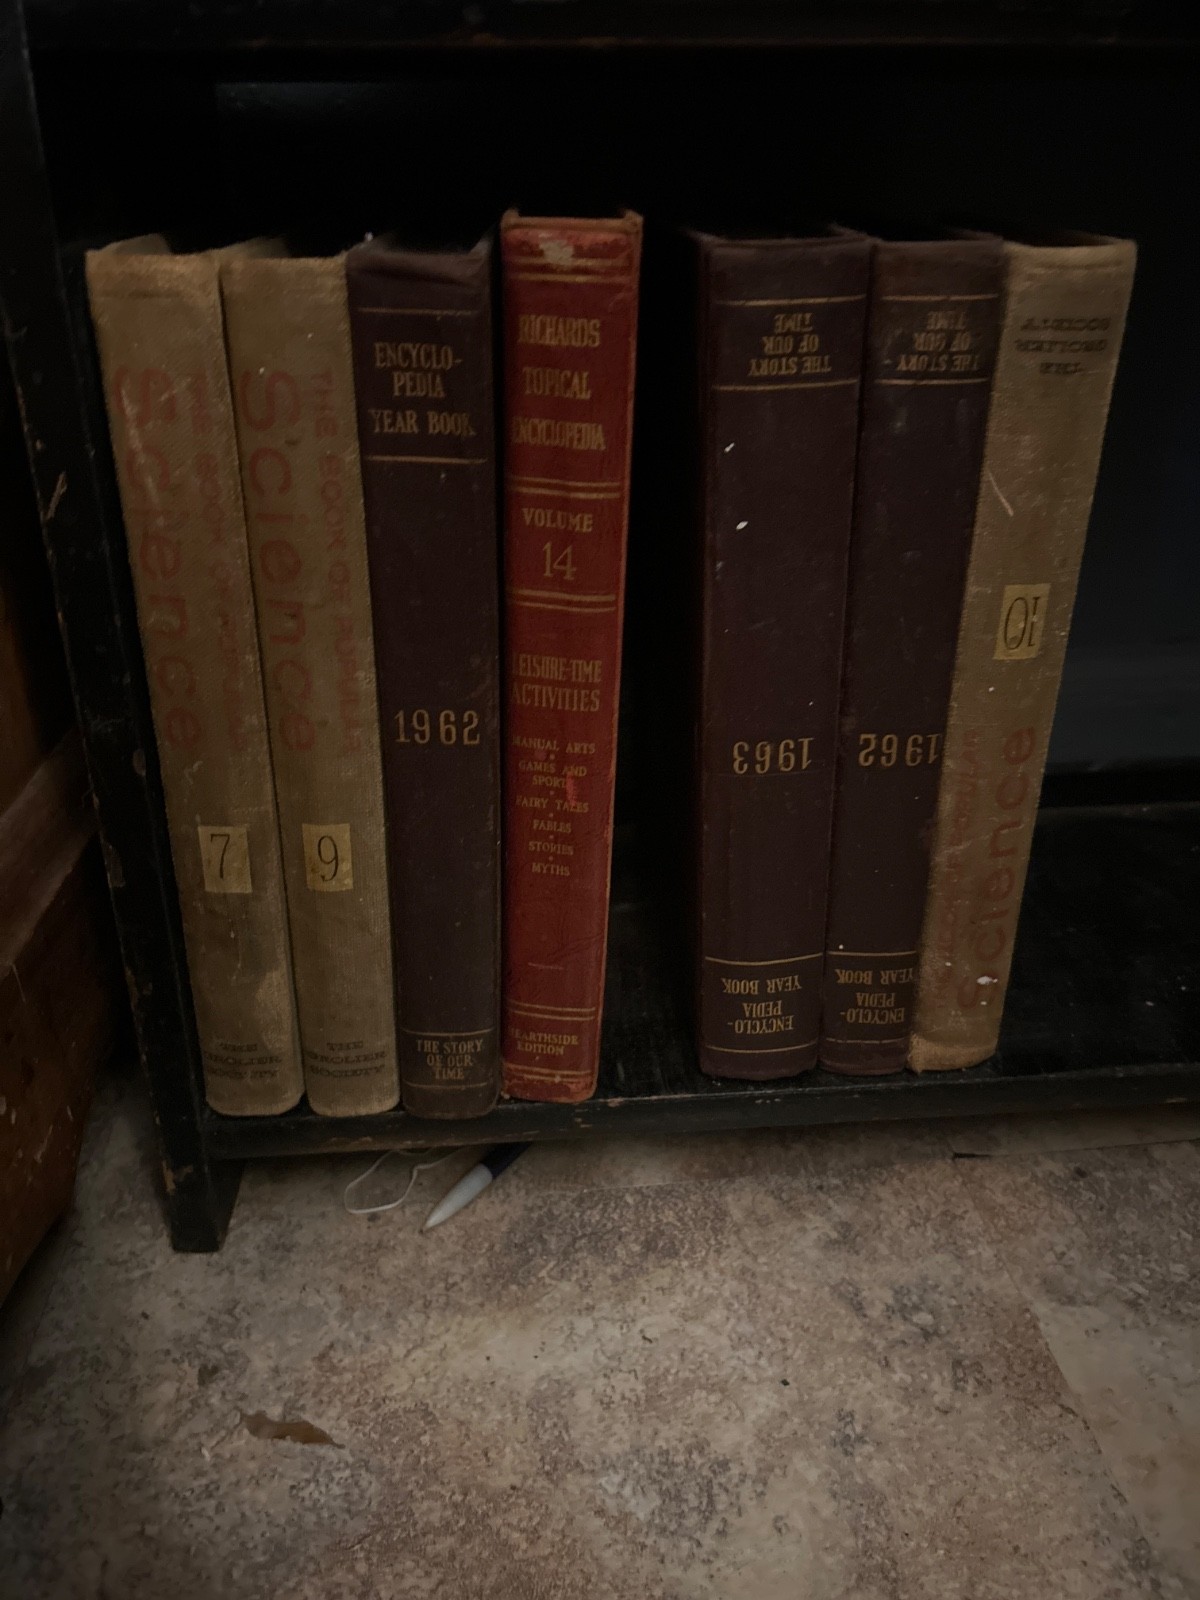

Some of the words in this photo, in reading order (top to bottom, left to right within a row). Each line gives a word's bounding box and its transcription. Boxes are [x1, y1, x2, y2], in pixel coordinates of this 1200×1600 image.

[517, 314, 600, 347] RICHARDS
[773, 312, 814, 334] TIME
[761, 335, 794, 355] OUR
[797, 334, 820, 353] OF
[949, 332, 971, 351] OF
[373, 341, 464, 370] ENCYCLO-
[801, 354, 832, 374] THE
[896, 354, 947, 372] STORY
[952, 354, 980, 372] THE
[747, 357, 798, 376] STORY
[392, 371, 446, 399] PEDIA
[522, 367, 591, 399] TOPICAL
[368, 408, 419, 434] YEAR
[427, 410, 477, 437] BOOK
[512, 416, 606, 450] ENCYCLOPEDIA
[521, 508, 593, 532] VOLUME
[239, 369, 317, 751] Science
[542, 541, 577, 581] 14
[1004, 596, 1040, 650] 10
[512, 652, 602, 683] LEISURE-TIME
[512, 683, 600, 712] ACTIVITIES
[394, 709, 481, 746] 1962
[512, 736, 560, 751] MANUAL
[566, 742, 596, 754] ARTS
[858, 733, 943, 767] 1962
[732, 737, 815, 775] 1963
[519, 760, 556, 774] GAMES
[562, 764, 587, 777] AND
[532, 775, 573, 789] SPORT
[533, 819, 572, 834] FABLES
[211, 833, 230, 879] 7
[528, 841, 574, 855] STORIES
[318, 835, 338, 881] 9
[532, 863, 570, 876] MYTHS
[766, 975, 802, 993] YEAR
[834, 968, 873, 985] BOOK
[880, 968, 914, 984] YEAR
[720, 977, 760, 995] BOOK
[742, 1000, 782, 1017] PEDIA
[855, 992, 896, 1007] PEDIA
[727, 1015, 794, 1034] ENCYCLO-
[839, 1007, 905, 1024] ENCYCLO-
[416, 1040, 439, 1052] THE
[443, 1039, 483, 1054] STORY
[517, 1041, 565, 1055] EDITION
[427, 1054, 444, 1067] OF
[447, 1054, 473, 1067] OUR
[434, 1066, 465, 1080] TIME
